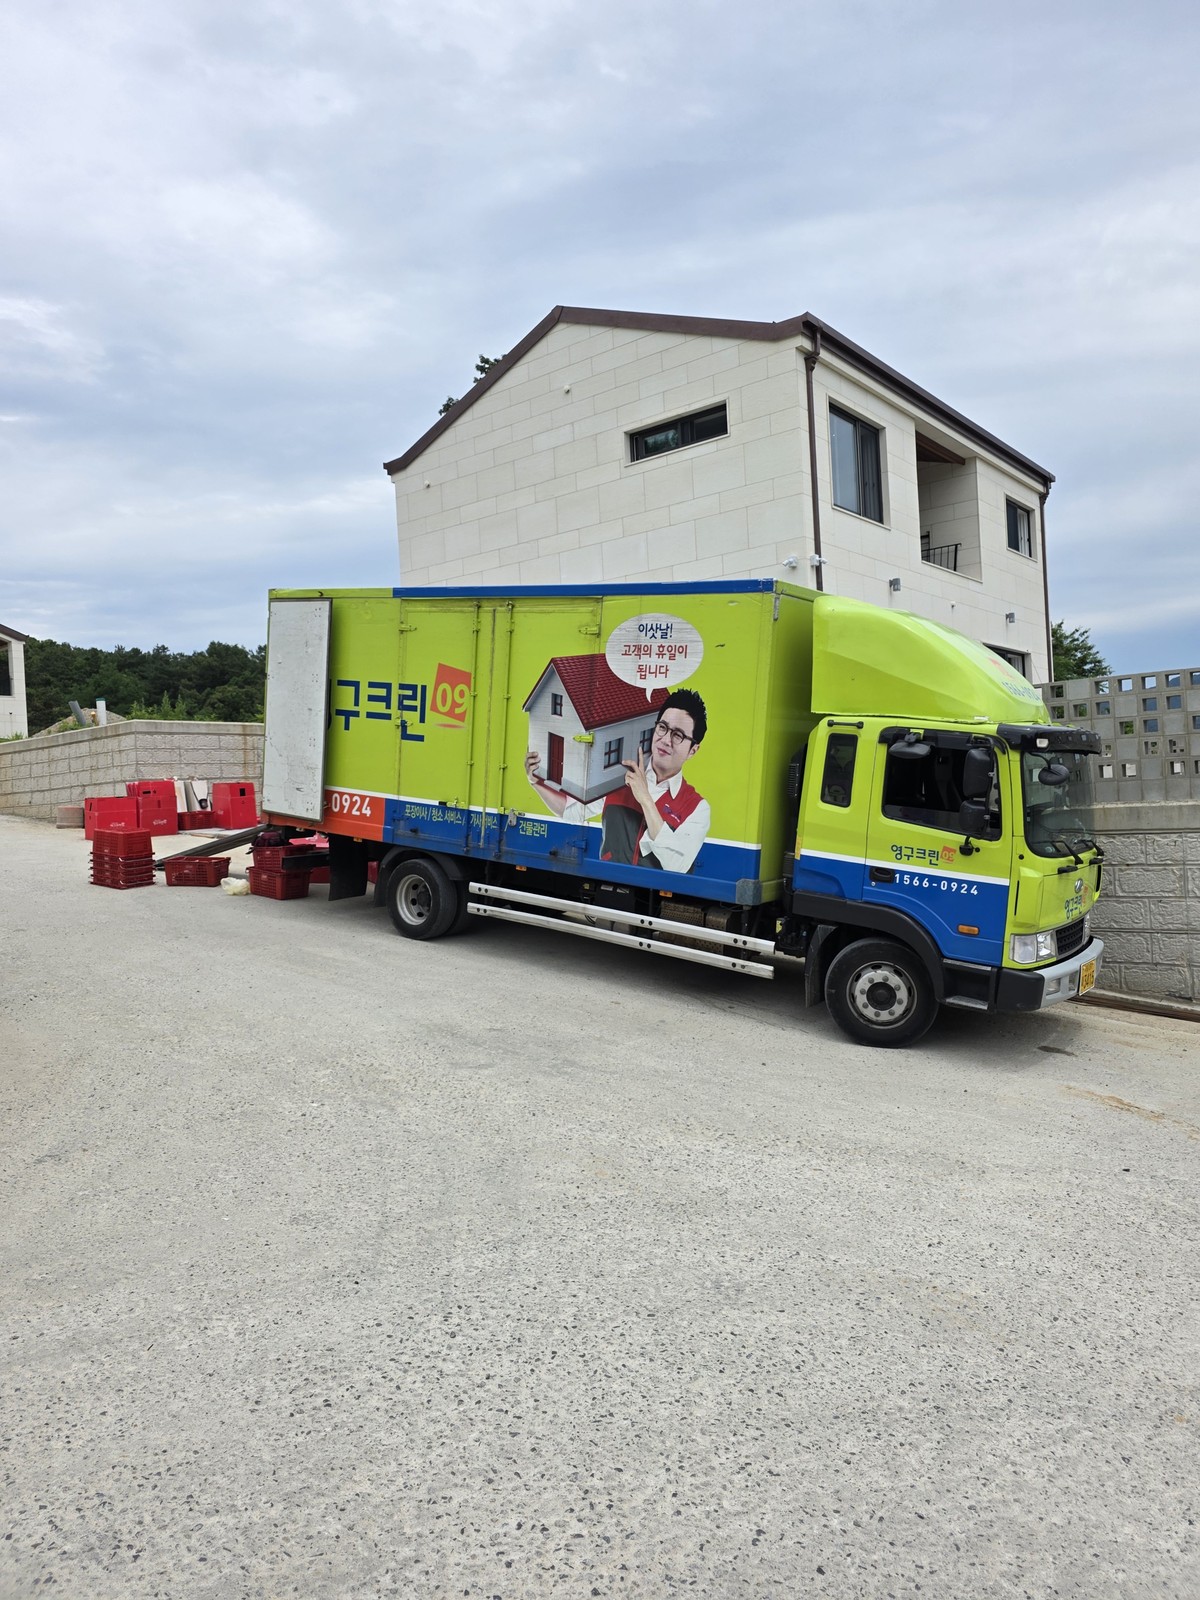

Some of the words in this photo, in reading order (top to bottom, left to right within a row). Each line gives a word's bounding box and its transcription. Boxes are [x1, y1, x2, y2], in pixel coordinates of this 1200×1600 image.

[638, 623, 673, 640] 이삿날!
[621, 644, 653, 660] 고객의
[655, 644, 688, 661] 휴일이
[637, 664, 669, 680] 됩니다
[327, 678, 427, 742] 구크린
[436, 682, 471, 715] 09
[331, 793, 372, 817] 0924
[405, 804, 428, 820] 포장이사
[518, 820, 548, 838] 건물관리
[890, 844, 940, 867] 영구크린
[894, 873, 979, 896] 1566-0924
